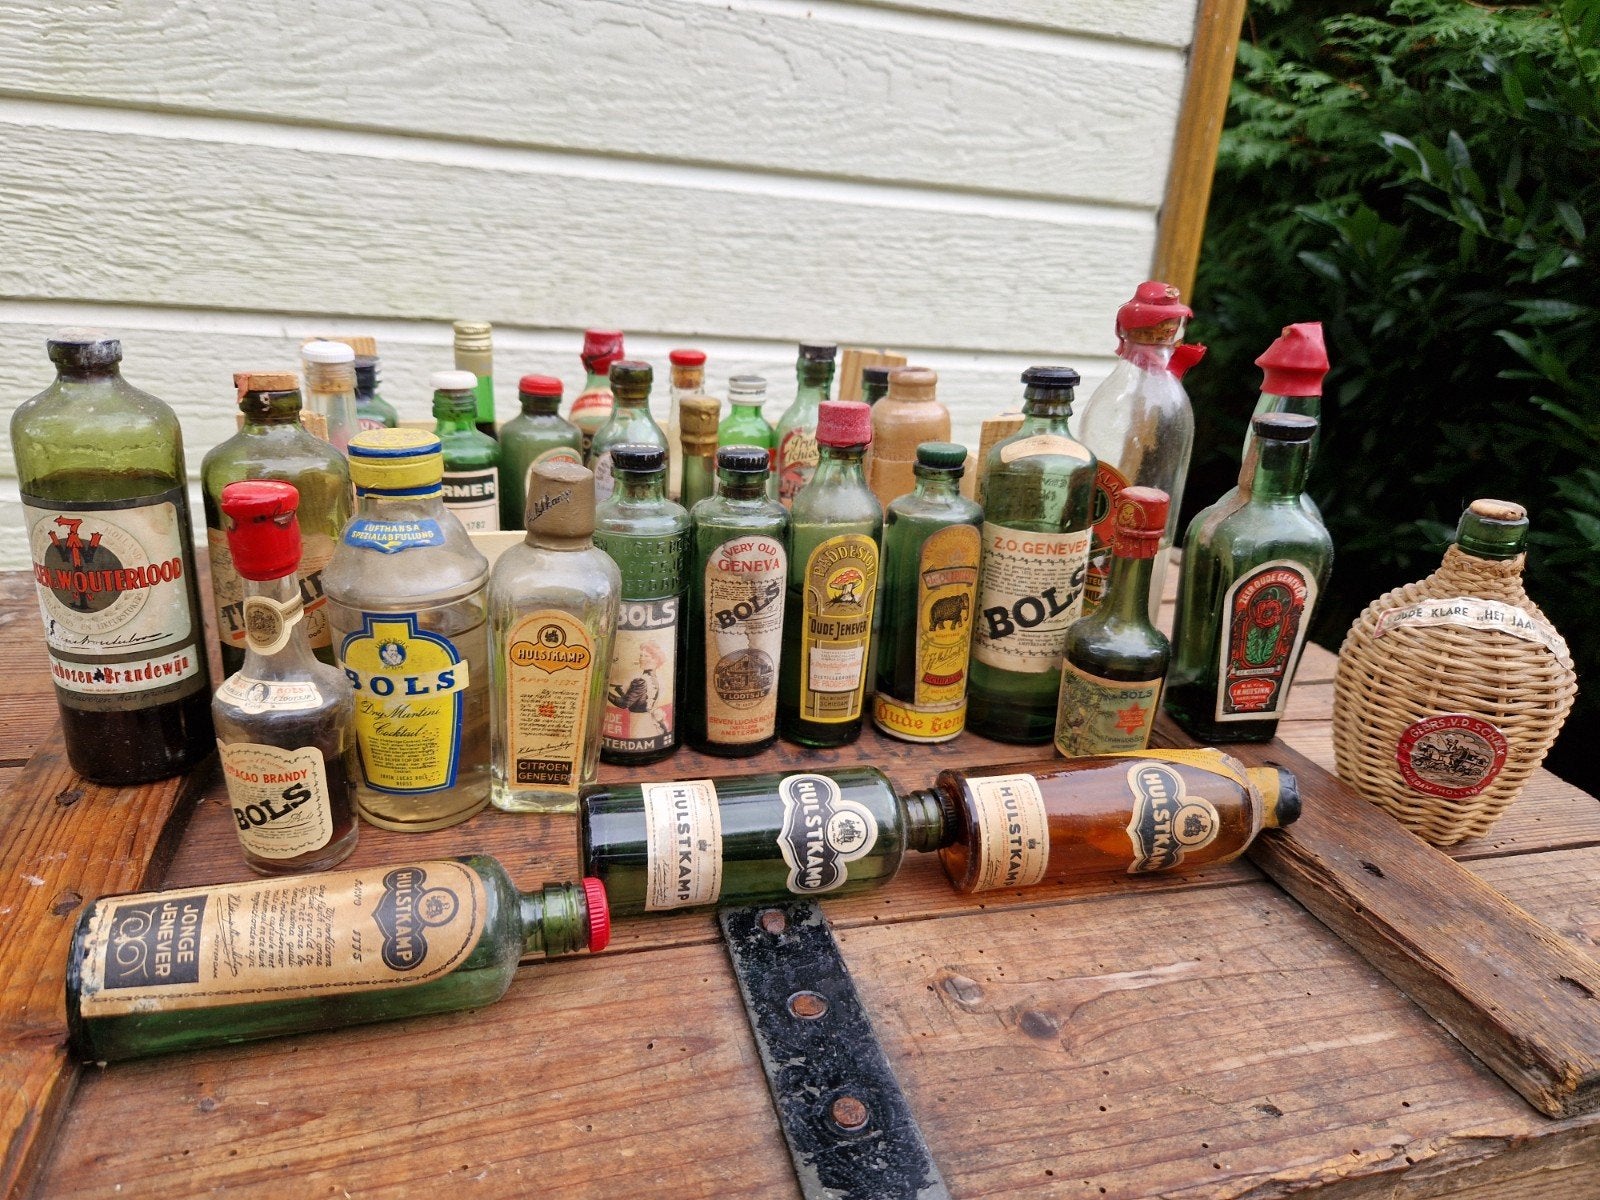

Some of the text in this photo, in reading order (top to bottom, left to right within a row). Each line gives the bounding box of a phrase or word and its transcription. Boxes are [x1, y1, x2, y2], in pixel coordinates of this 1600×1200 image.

[364, 524, 420, 532] LUFTHANSA
[725, 543, 777, 557] VERY OLD
[56, 557, 184, 593] WOUTERLOOD
[718, 558, 780, 572] GENEVA
[1238, 586, 1255, 604] ZEER
[1254, 573, 1276, 589] OUDE
[715, 581, 780, 630] BOLS
[984, 562, 1086, 640] BOLS
[1431, 607, 1468, 617] KLARE
[617, 601, 676, 627] BOLS
[811, 619, 867, 640] OUDE JENEVER
[519, 649, 585, 663] HULSTKAMP
[344, 669, 456, 696] BOLS
[1120, 690, 1152, 699] BOLS
[360, 700, 386, 720] Dry
[735, 717, 758, 725] LUCAS
[877, 703, 924, 729] Oude
[373, 721, 427, 737] Cocktail
[263, 769, 307, 784] BRANDY
[518, 772, 571, 781] GENEVER
[520, 762, 569, 771] CITROEN
[233, 782, 312, 830] BOLS
[673, 789, 692, 901] HULSTKAMP
[798, 782, 824, 888] HULSTKAMP
[395, 871, 413, 961] HULSTKAMP
[155, 902, 178, 977] JENEVER
[177, 904, 199, 964] JONGE
